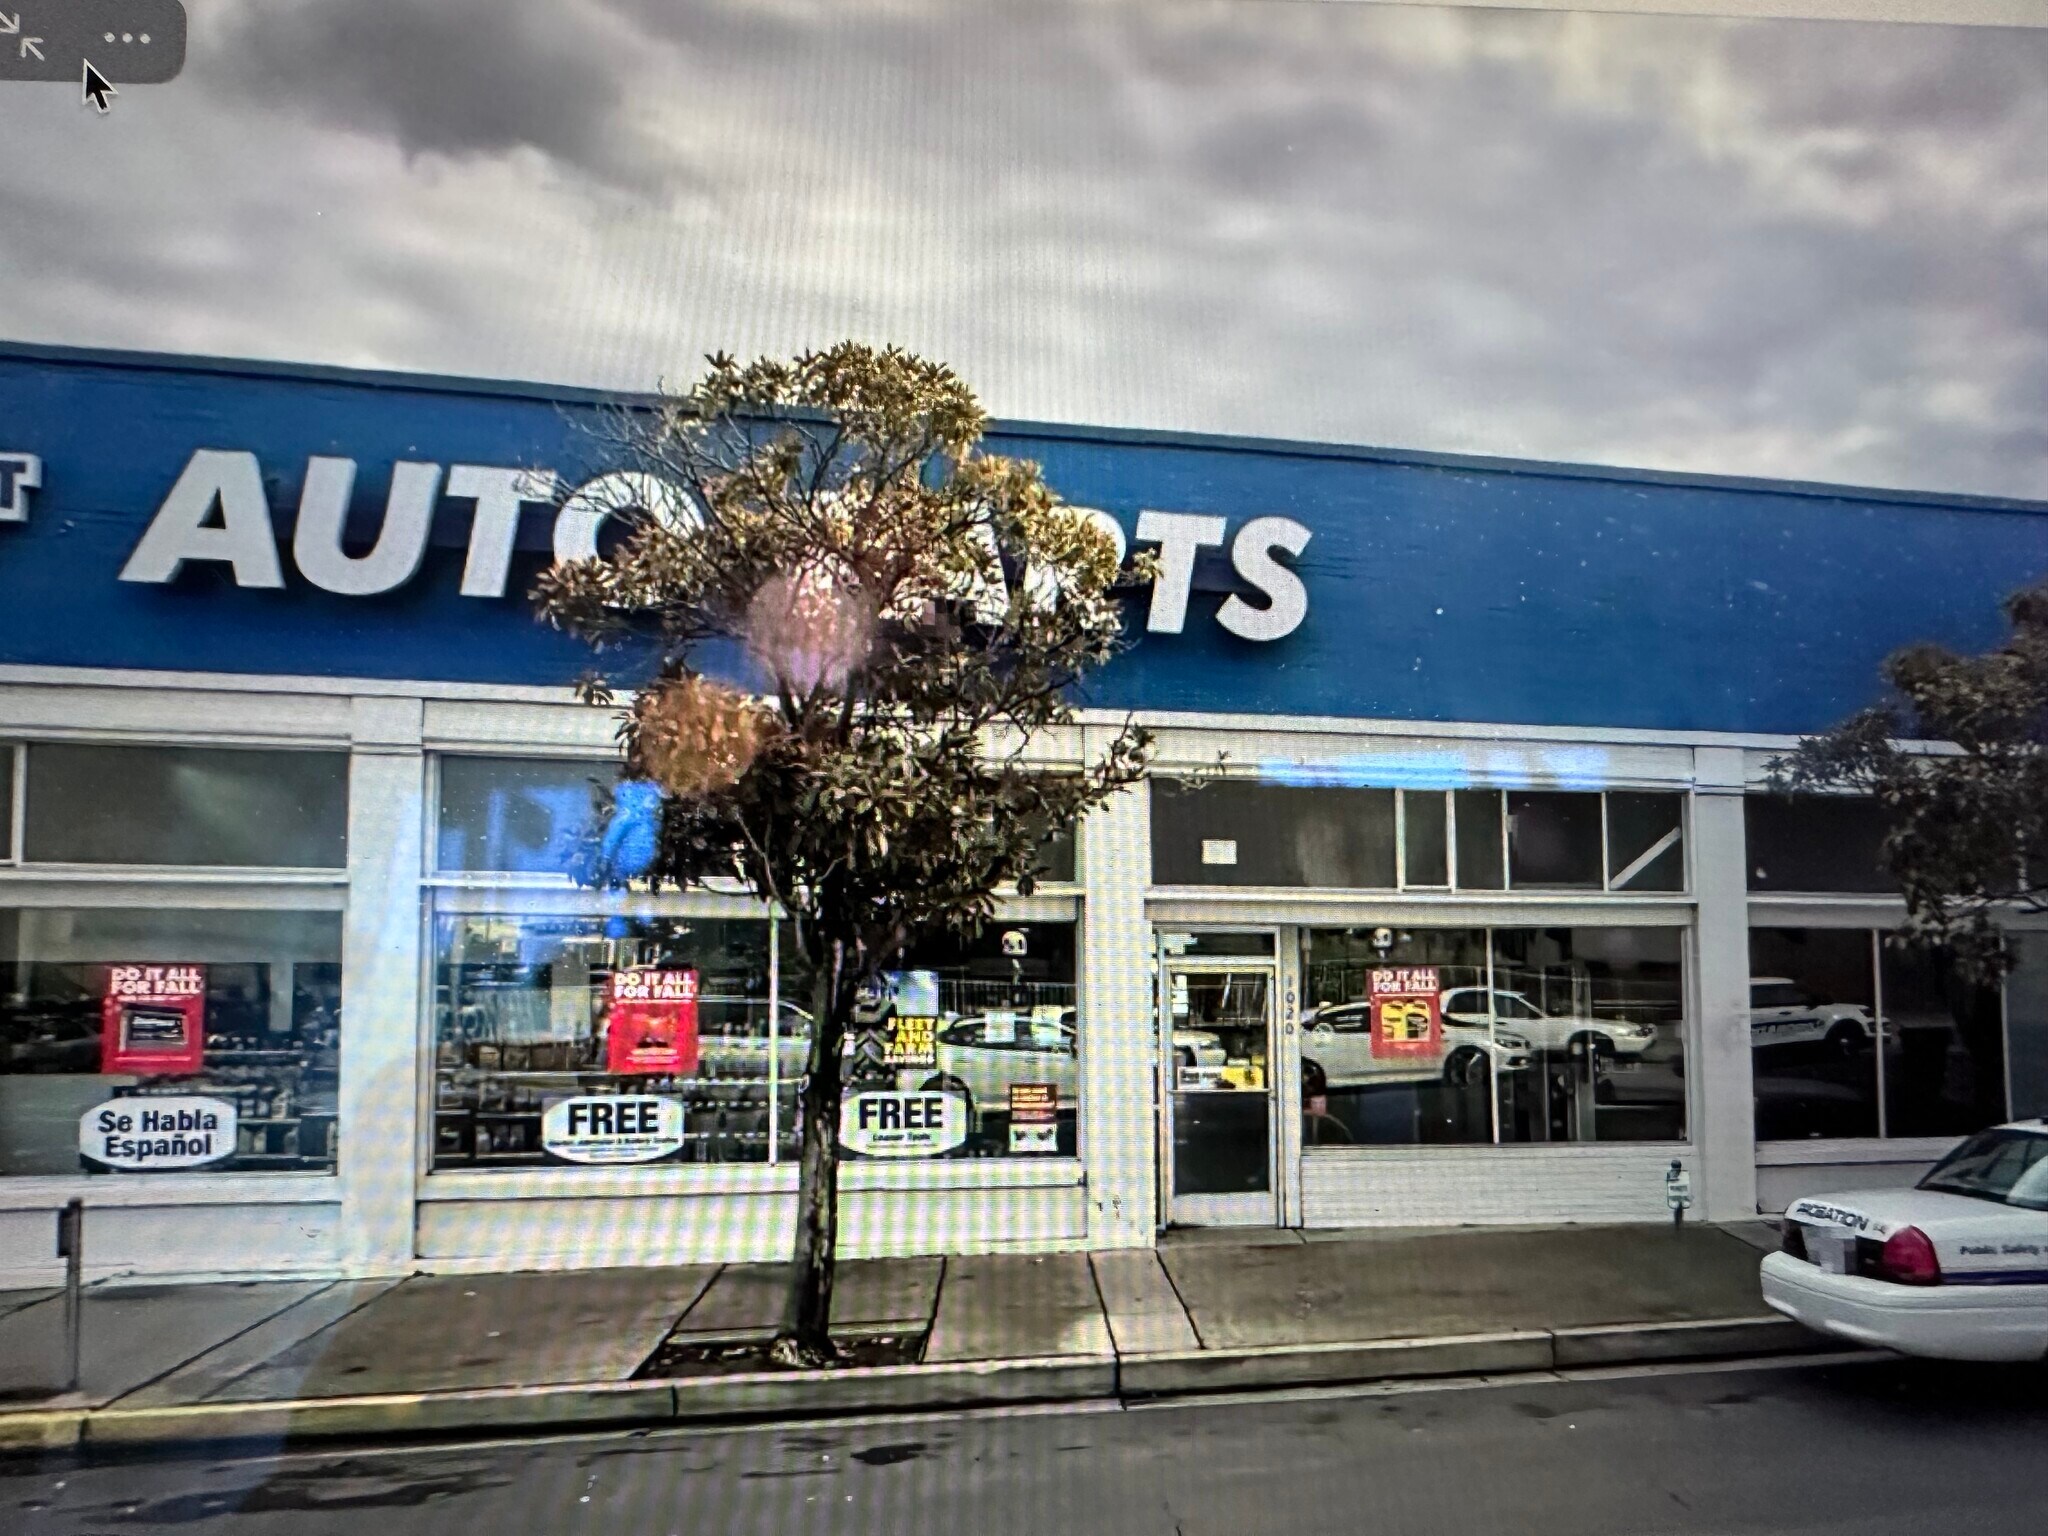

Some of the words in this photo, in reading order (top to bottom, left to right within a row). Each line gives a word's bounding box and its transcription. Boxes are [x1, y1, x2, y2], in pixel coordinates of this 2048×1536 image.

[118, 448, 706, 606] AUTO
[111, 967, 141, 981] DO
[144, 967, 163, 981] IT
[165, 967, 202, 981] ALL
[614, 972, 641, 986] DO
[644, 972, 661, 986] IT
[662, 972, 694, 986] ALL
[1372, 970, 1394, 982] DO
[1396, 970, 1410, 981] IT
[1411, 969, 1435, 980] ALL
[110, 980, 151, 994] FOR
[154, 980, 201, 994] FALL
[614, 985, 649, 998] FOR
[653, 985, 694, 998] FALL
[1373, 982, 1401, 992] FOR
[1405, 981, 1437, 992] FALL
[568, 1102, 660, 1135] FREE
[859, 1097, 944, 1129] FREE
[98, 1111, 134, 1133] Se
[142, 1109, 218, 1132] Habla
[105, 1133, 212, 1161] Español
